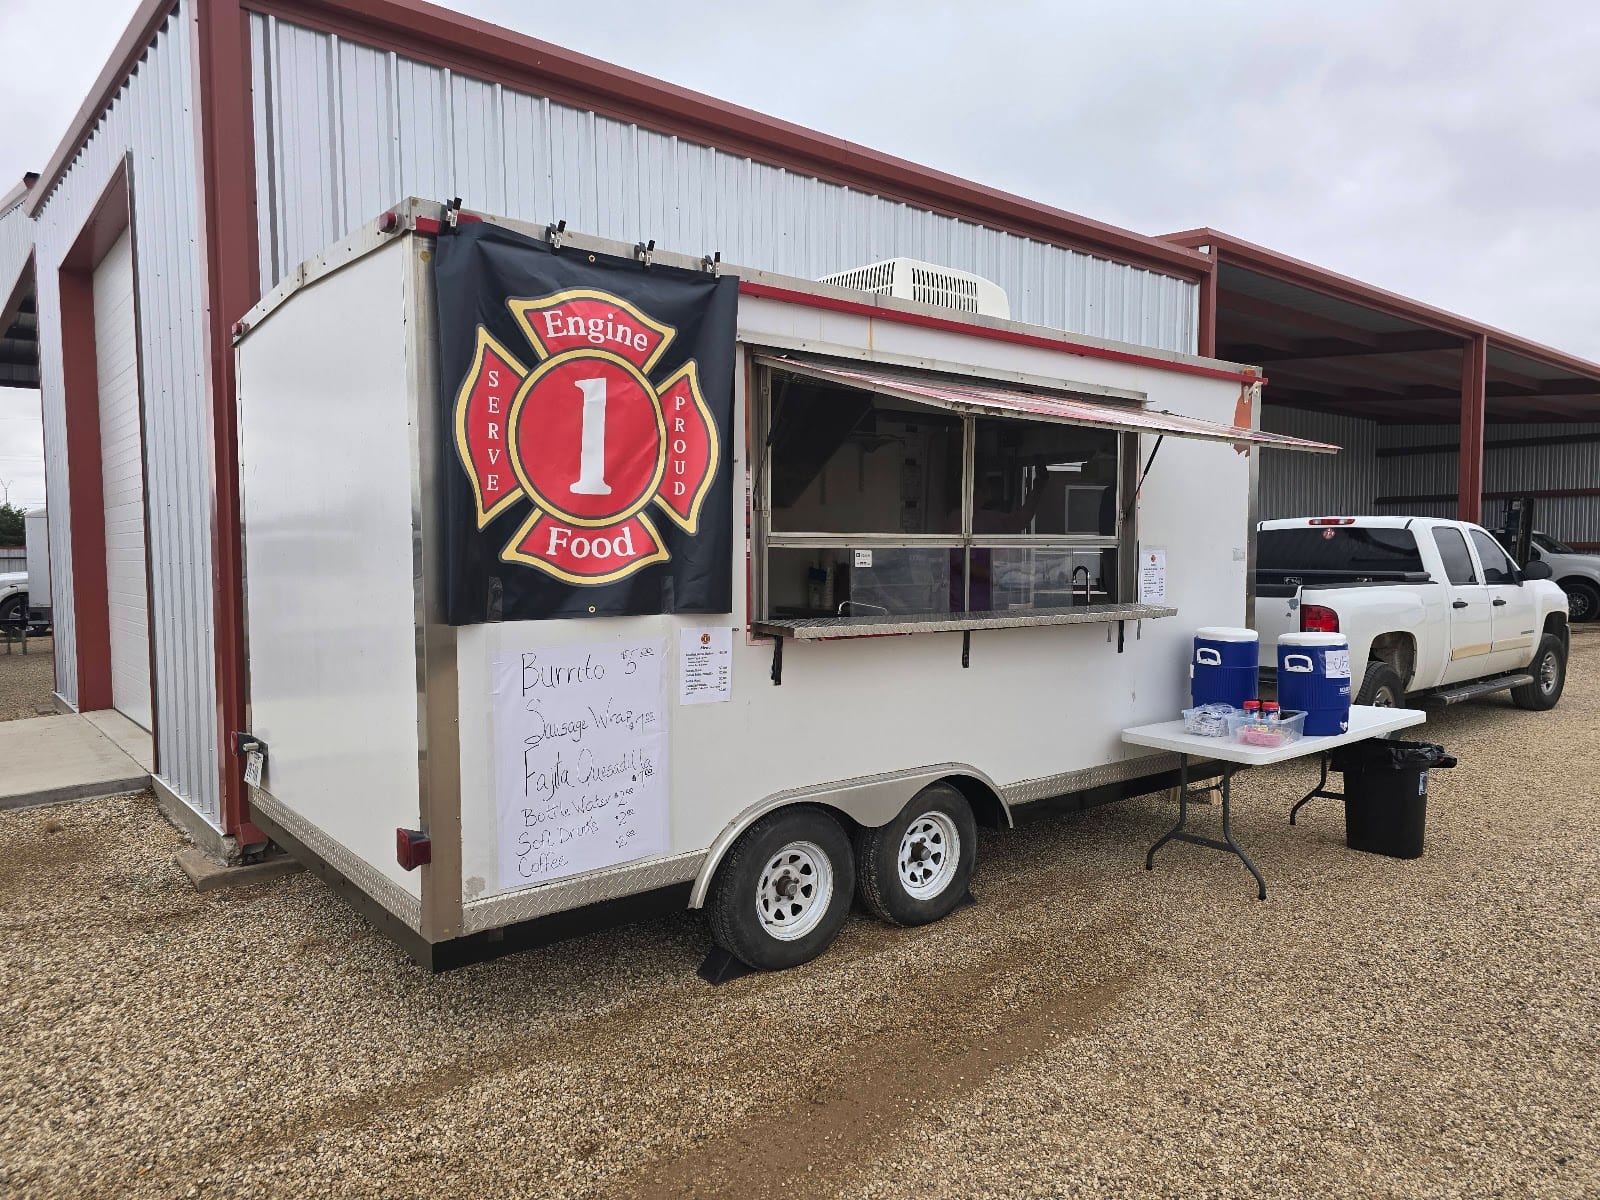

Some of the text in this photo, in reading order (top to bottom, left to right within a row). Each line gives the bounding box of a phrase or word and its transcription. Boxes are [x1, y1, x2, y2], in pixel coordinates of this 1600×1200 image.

[542, 309, 648, 352] Engine
[488, 370, 500, 491] SERVE
[569, 377, 612, 495] 1
[673, 396, 687, 496] PROUD
[545, 526, 637, 559] Food
[521, 652, 605, 697] Burrito
[523, 698, 589, 745] Sausage
[587, 696, 633, 729] Wrap
[524, 743, 575, 802] Fajita
[521, 801, 571, 827] Bottle
[571, 794, 612, 814] Water
[515, 829, 555, 857] Soft
[518, 851, 569, 878] Coffee
